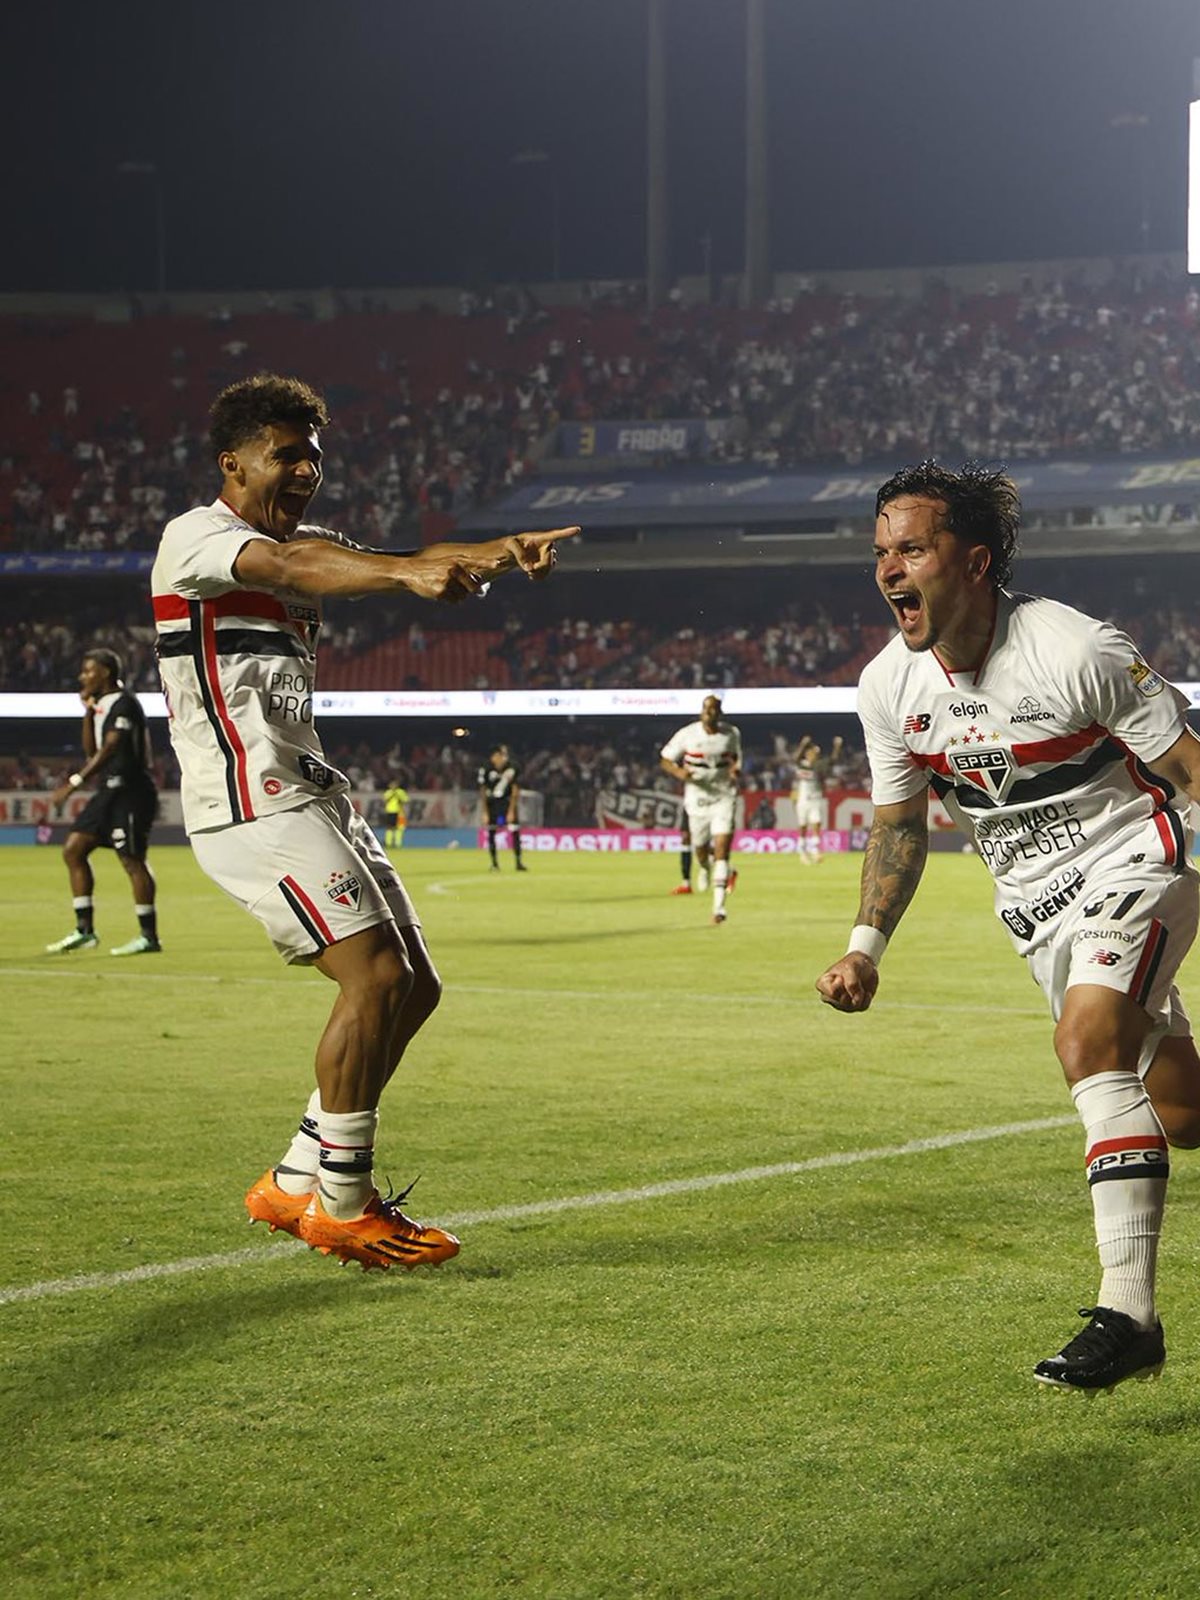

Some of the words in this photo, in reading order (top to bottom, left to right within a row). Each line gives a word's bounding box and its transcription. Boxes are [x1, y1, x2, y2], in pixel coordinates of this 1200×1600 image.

[580, 424, 595, 456] 3
[949, 701, 989, 720] elgin
[957, 753, 1004, 769] SPFC
[329, 877, 358, 897] SPFC
